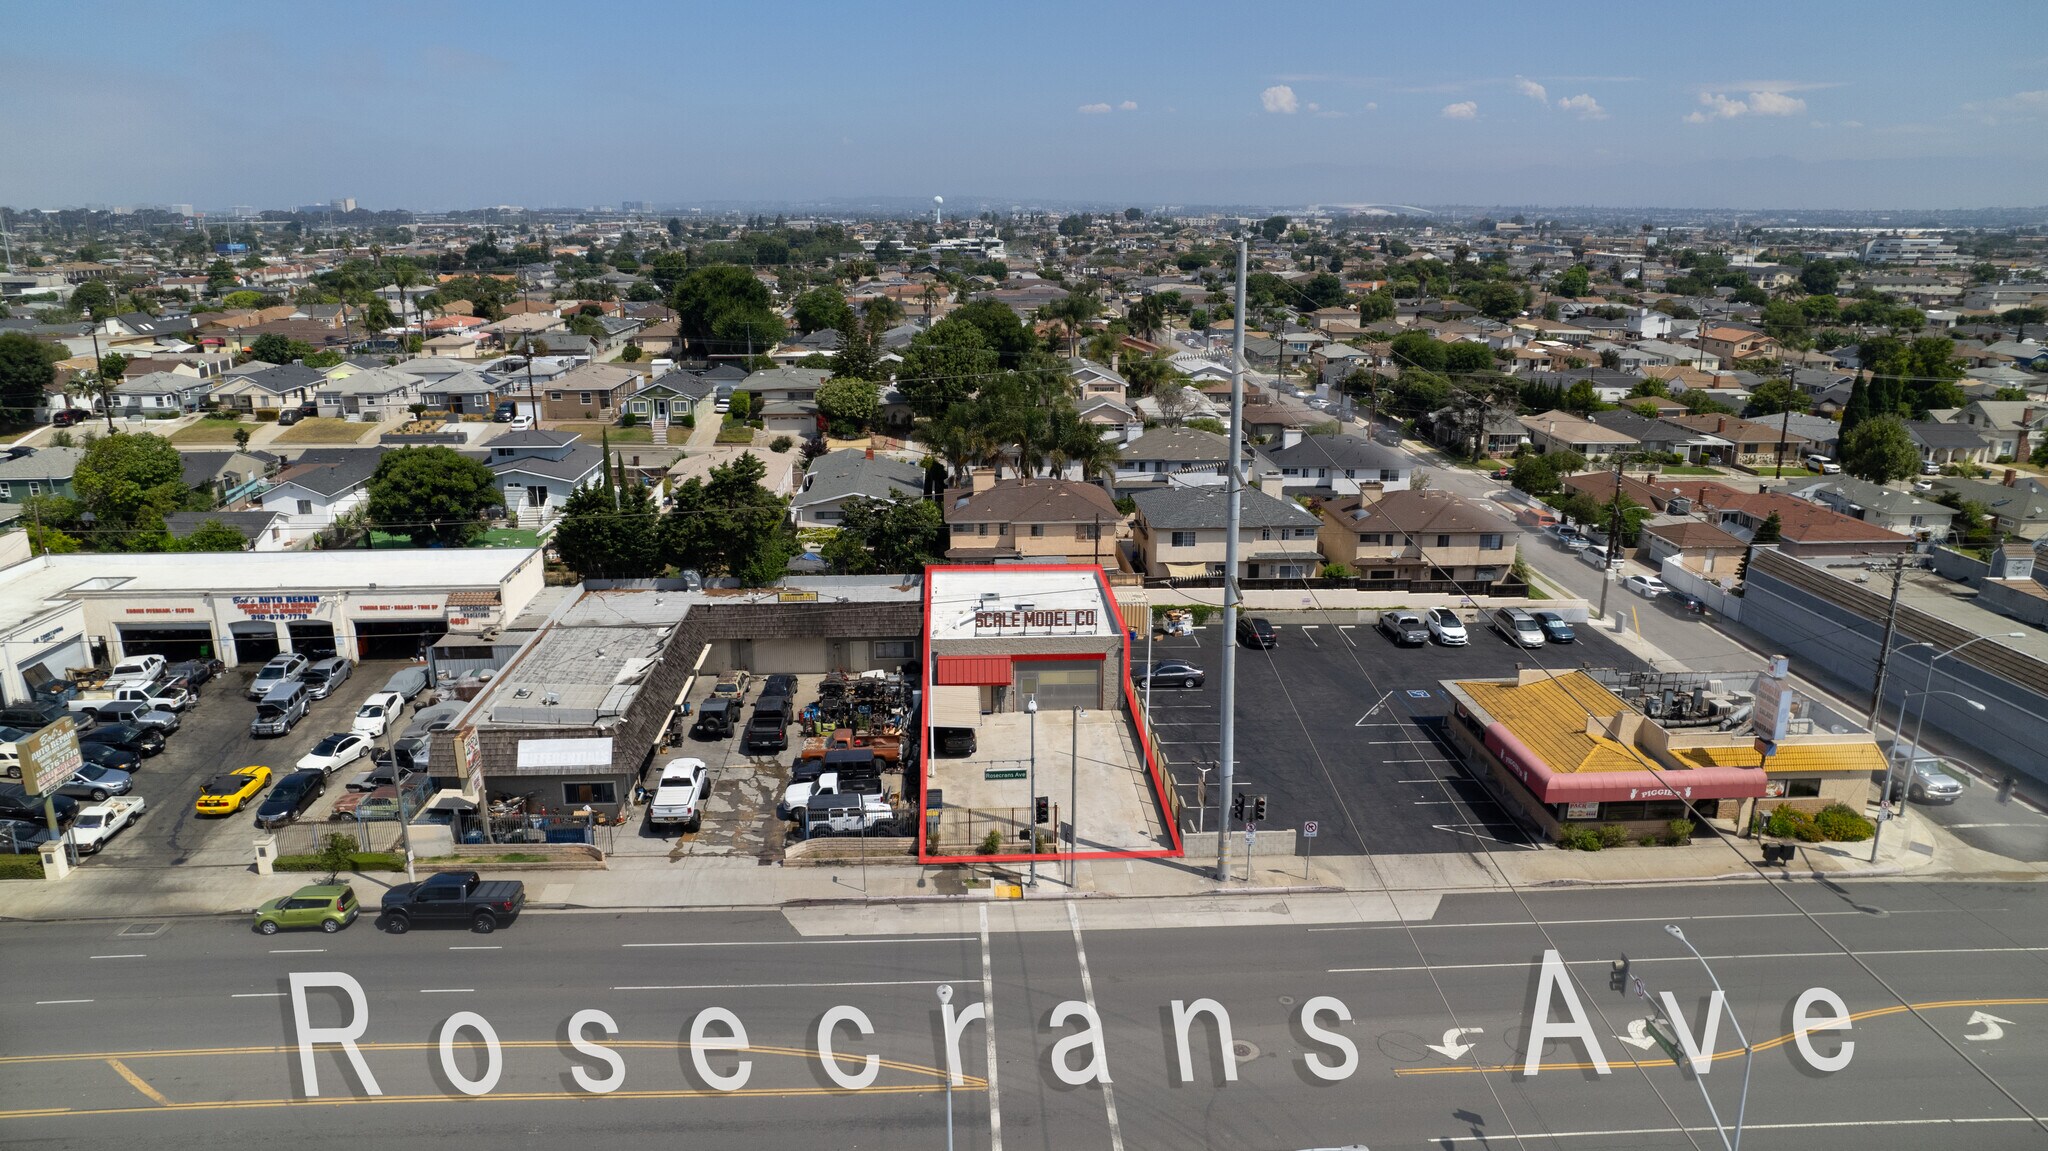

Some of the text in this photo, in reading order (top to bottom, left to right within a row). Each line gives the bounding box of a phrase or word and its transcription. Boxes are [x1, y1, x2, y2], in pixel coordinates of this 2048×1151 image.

[232, 596, 255, 604] Bob's
[975, 611, 1020, 628] SCALE
[1024, 610, 1072, 627] MODEL
[31, 745, 50, 761] AUTO
[51, 729, 76, 749] REPAIR
[39, 728, 63, 746] Bob's
